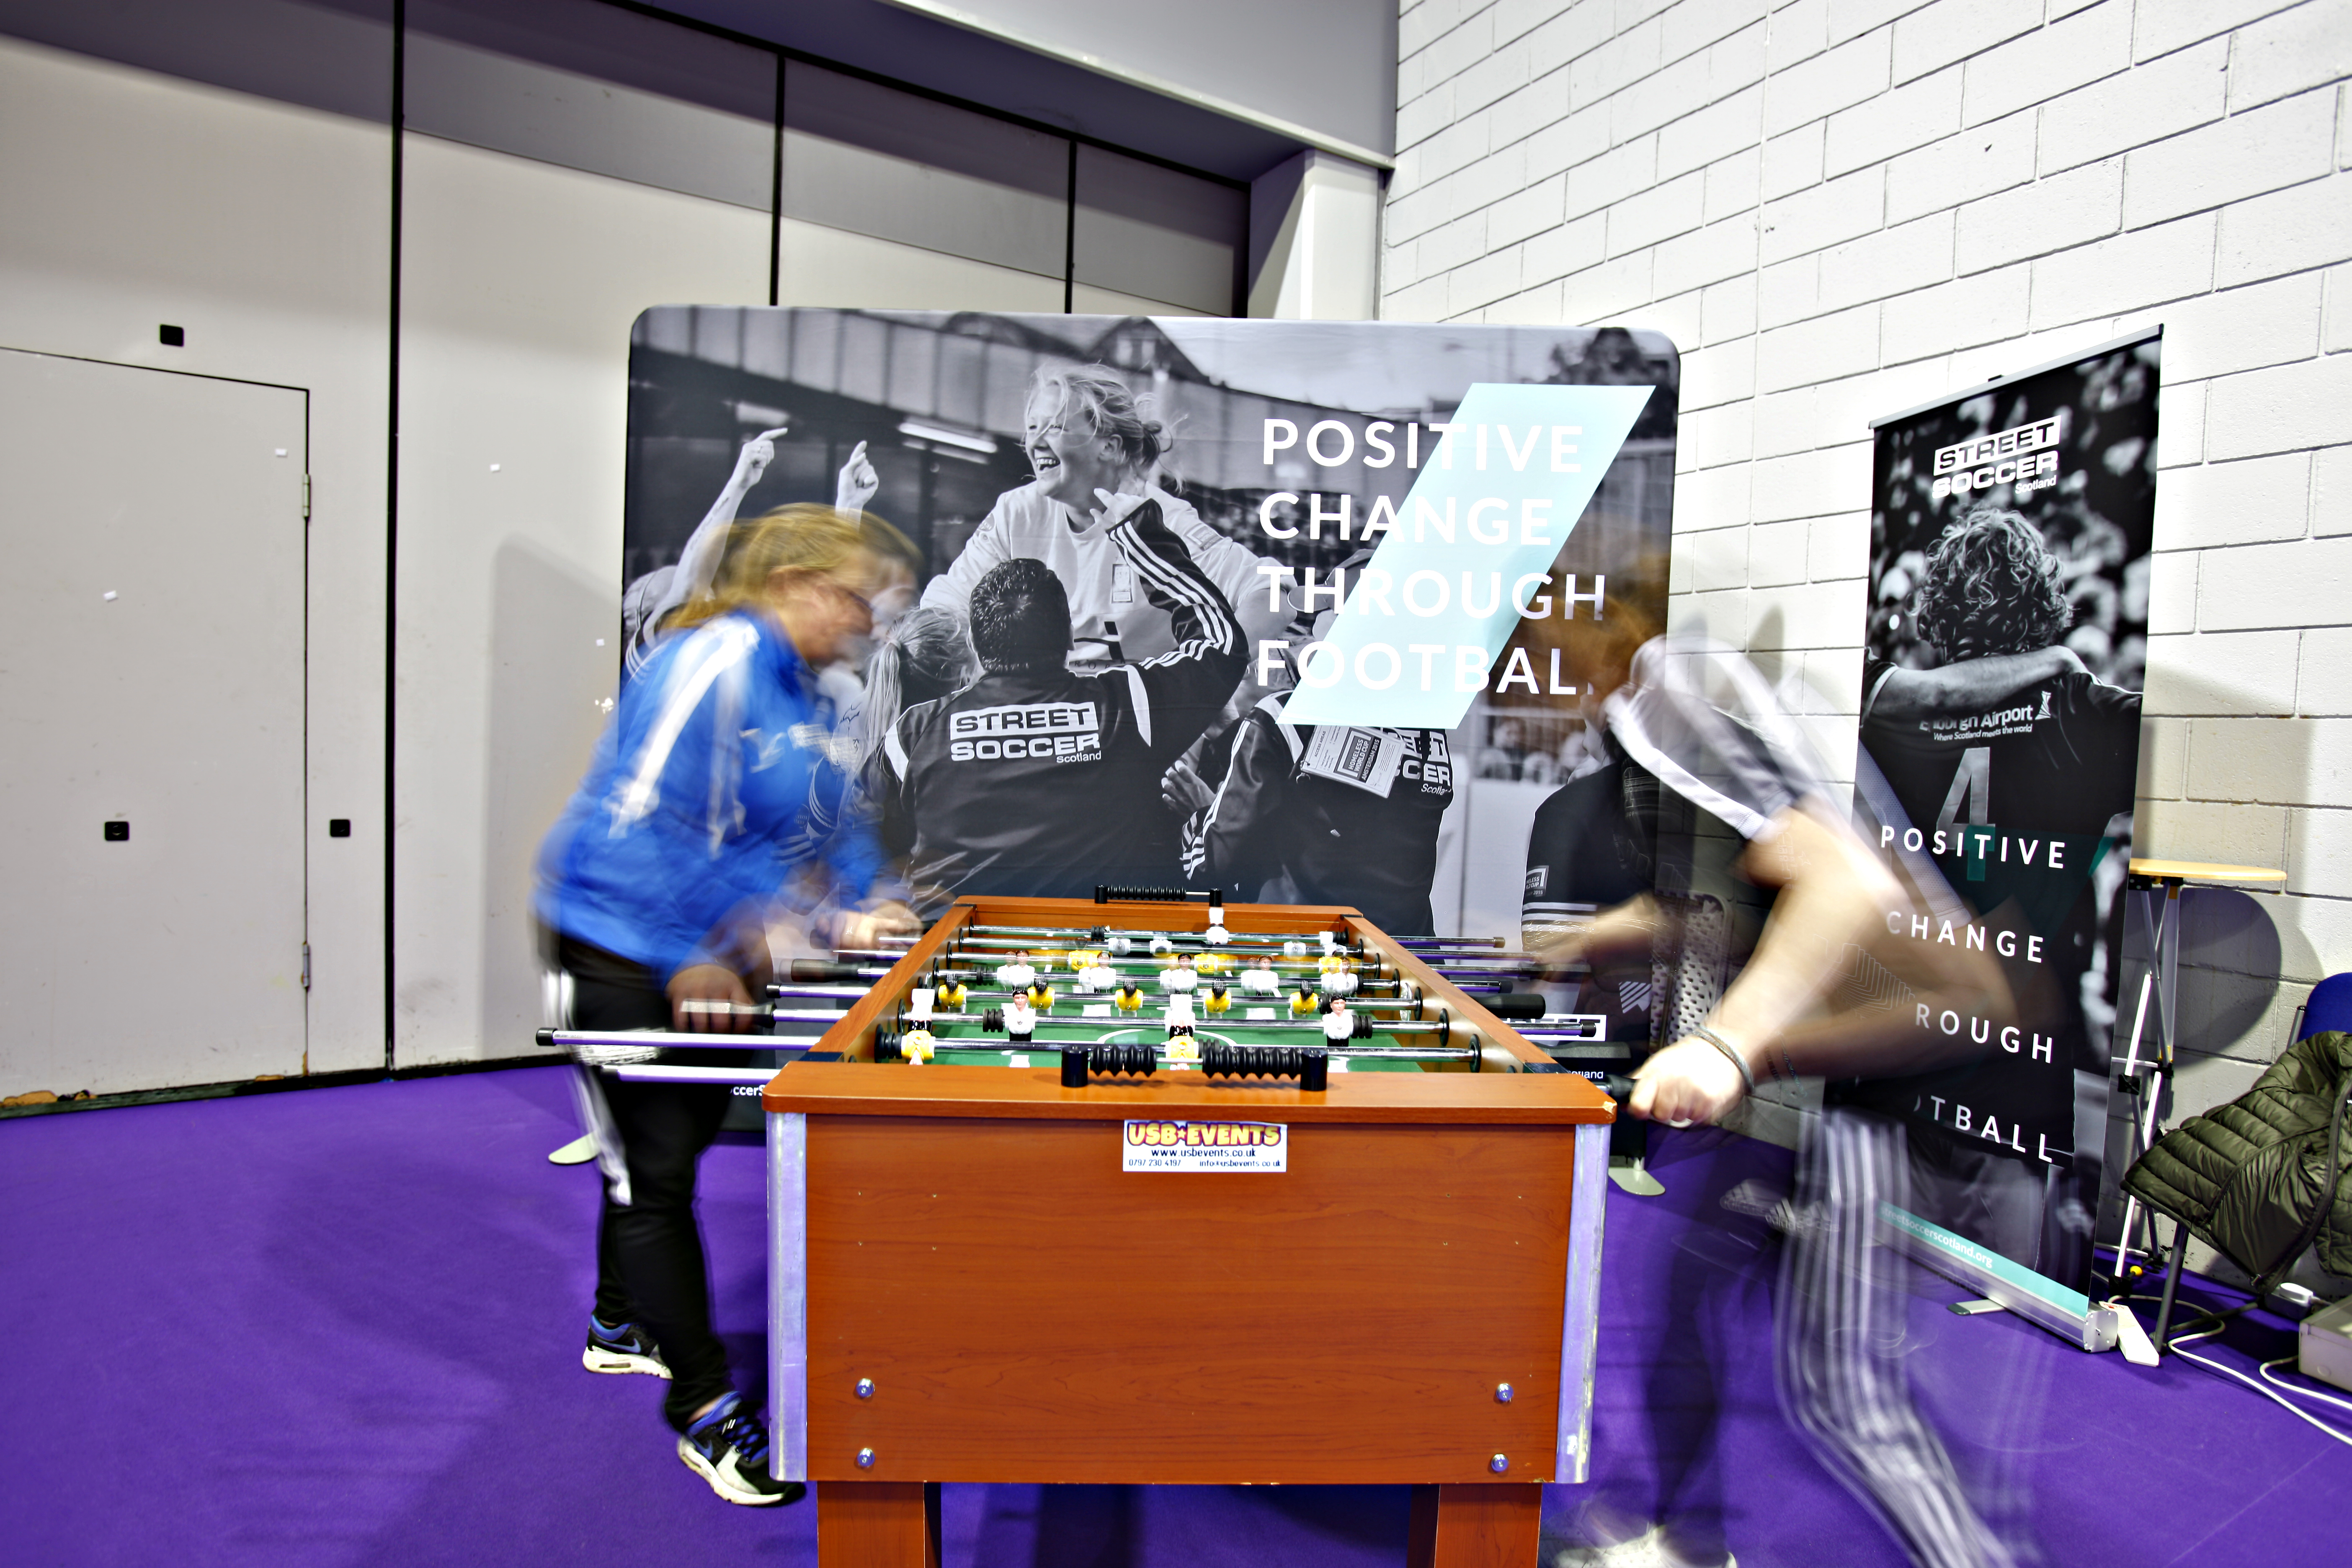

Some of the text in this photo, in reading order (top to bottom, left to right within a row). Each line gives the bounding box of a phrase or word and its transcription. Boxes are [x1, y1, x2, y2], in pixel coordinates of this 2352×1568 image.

[1263, 418, 1583, 473] POSITIVE
[1939, 421, 2055, 469] STREET
[1932, 450, 2059, 498] SOCCER
[2014, 475, 2057, 495] Scotland
[1259, 491, 1553, 546] CHANGE
[1256, 565, 1606, 621] THROUGH
[1258, 639, 1594, 695] FOOTBAL
[955, 708, 1090, 733] STREET
[1933, 732, 1953, 741] Where
[1954, 730, 1981, 740] Scotland
[1982, 729, 2001, 738] meets
[2014, 724, 2032, 733] world
[1981, 705, 2034, 728] Airport
[950, 733, 1101, 761] SOCCER
[1056, 750, 1102, 763] Scotland
[1348, 738, 1364, 770] HOMELESS
[1354, 740, 1370, 772] WORLD CUP
[1361, 739, 1380, 780] AMSTERDAM 2015
[1881, 825, 2066, 869] POSITIVE
[1886, 910, 2044, 964] CHANGE
[1916, 1003, 2053, 1064] ROUGH
[1127, 1122, 1282, 1147] USB EVENTS
[1151, 1147, 1256, 1158] www.usbevents.co.uk
[1164, 1159, 1181, 1167] 4197
[1880, 1204, 1994, 1269] streetsoccerscotland.org
